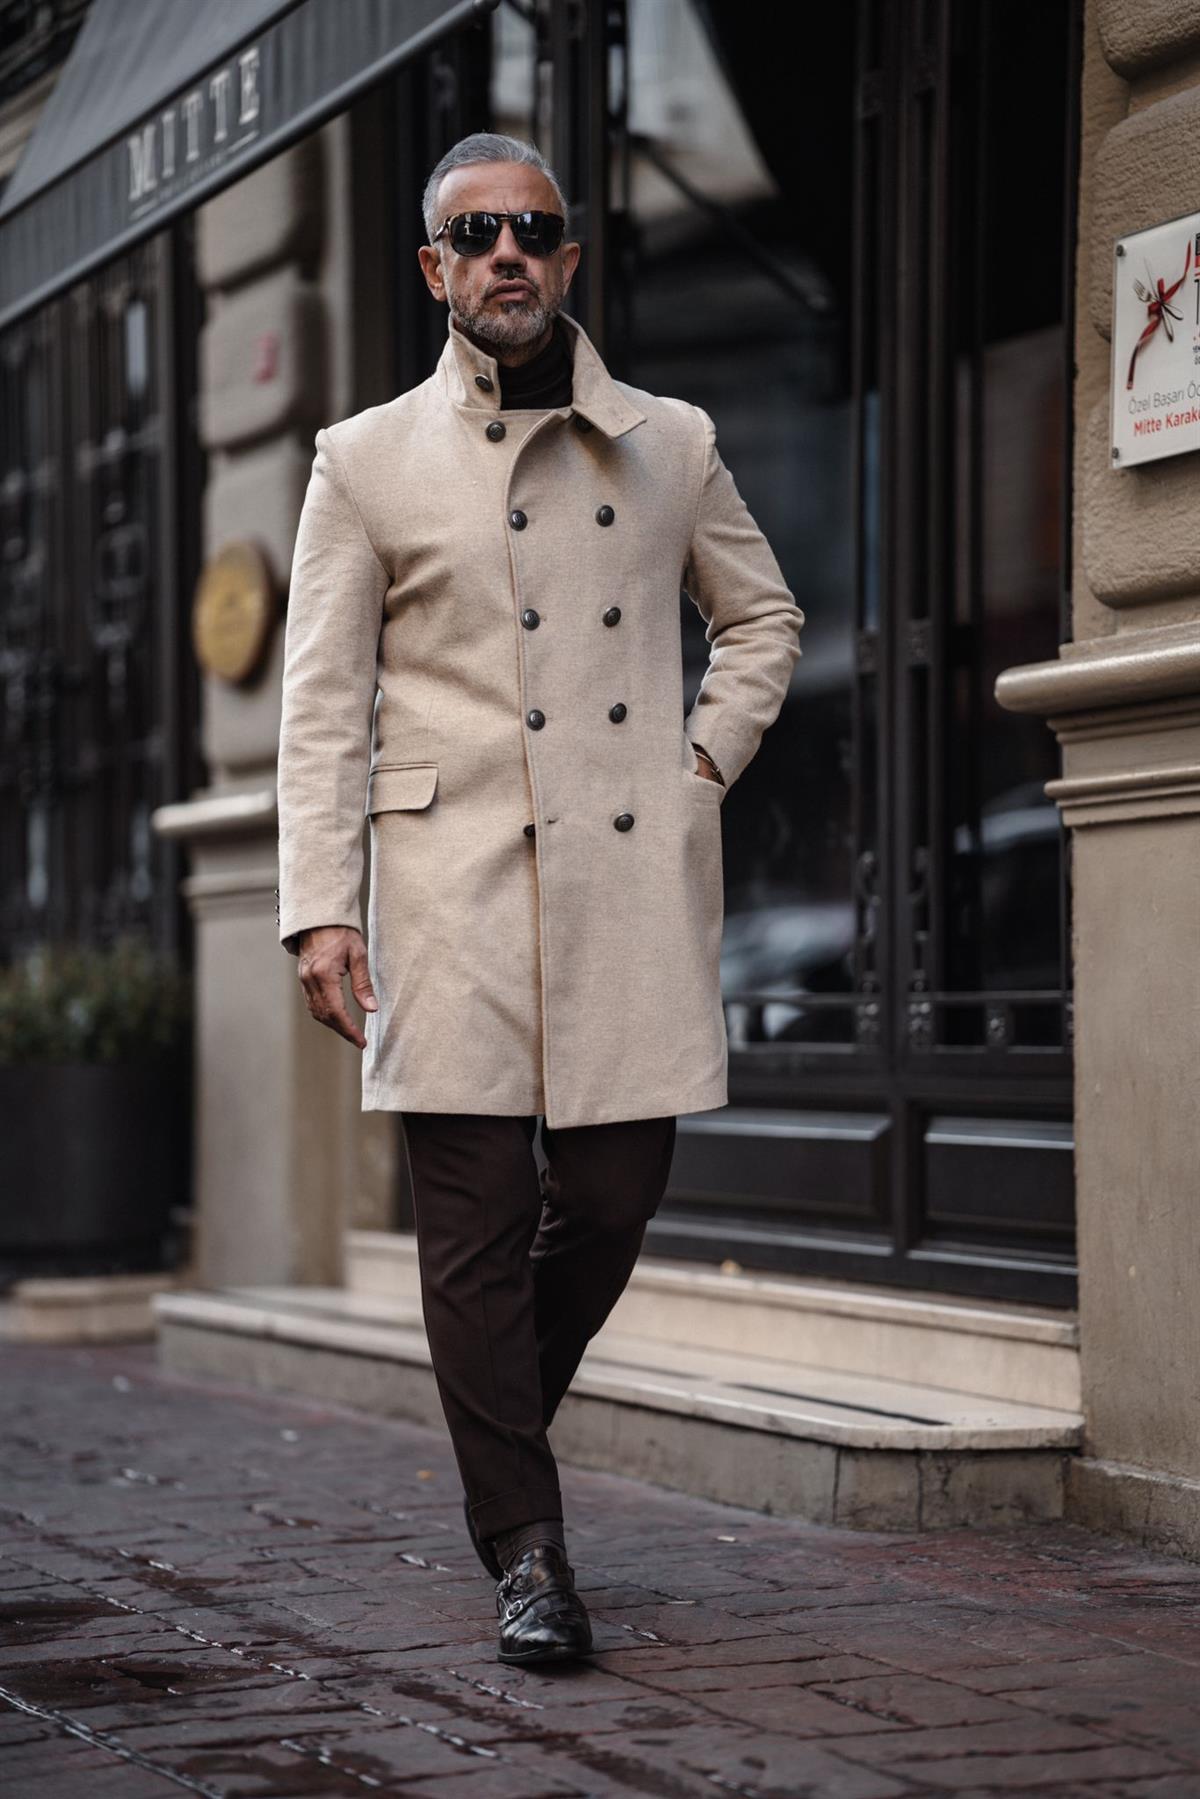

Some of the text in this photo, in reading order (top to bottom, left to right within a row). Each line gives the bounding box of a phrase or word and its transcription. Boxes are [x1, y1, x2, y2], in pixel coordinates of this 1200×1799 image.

[128, 48, 260, 200] MITTE
[1129, 396, 1150, 414] Özel
[1134, 406, 1200, 437] Mitte Karak
